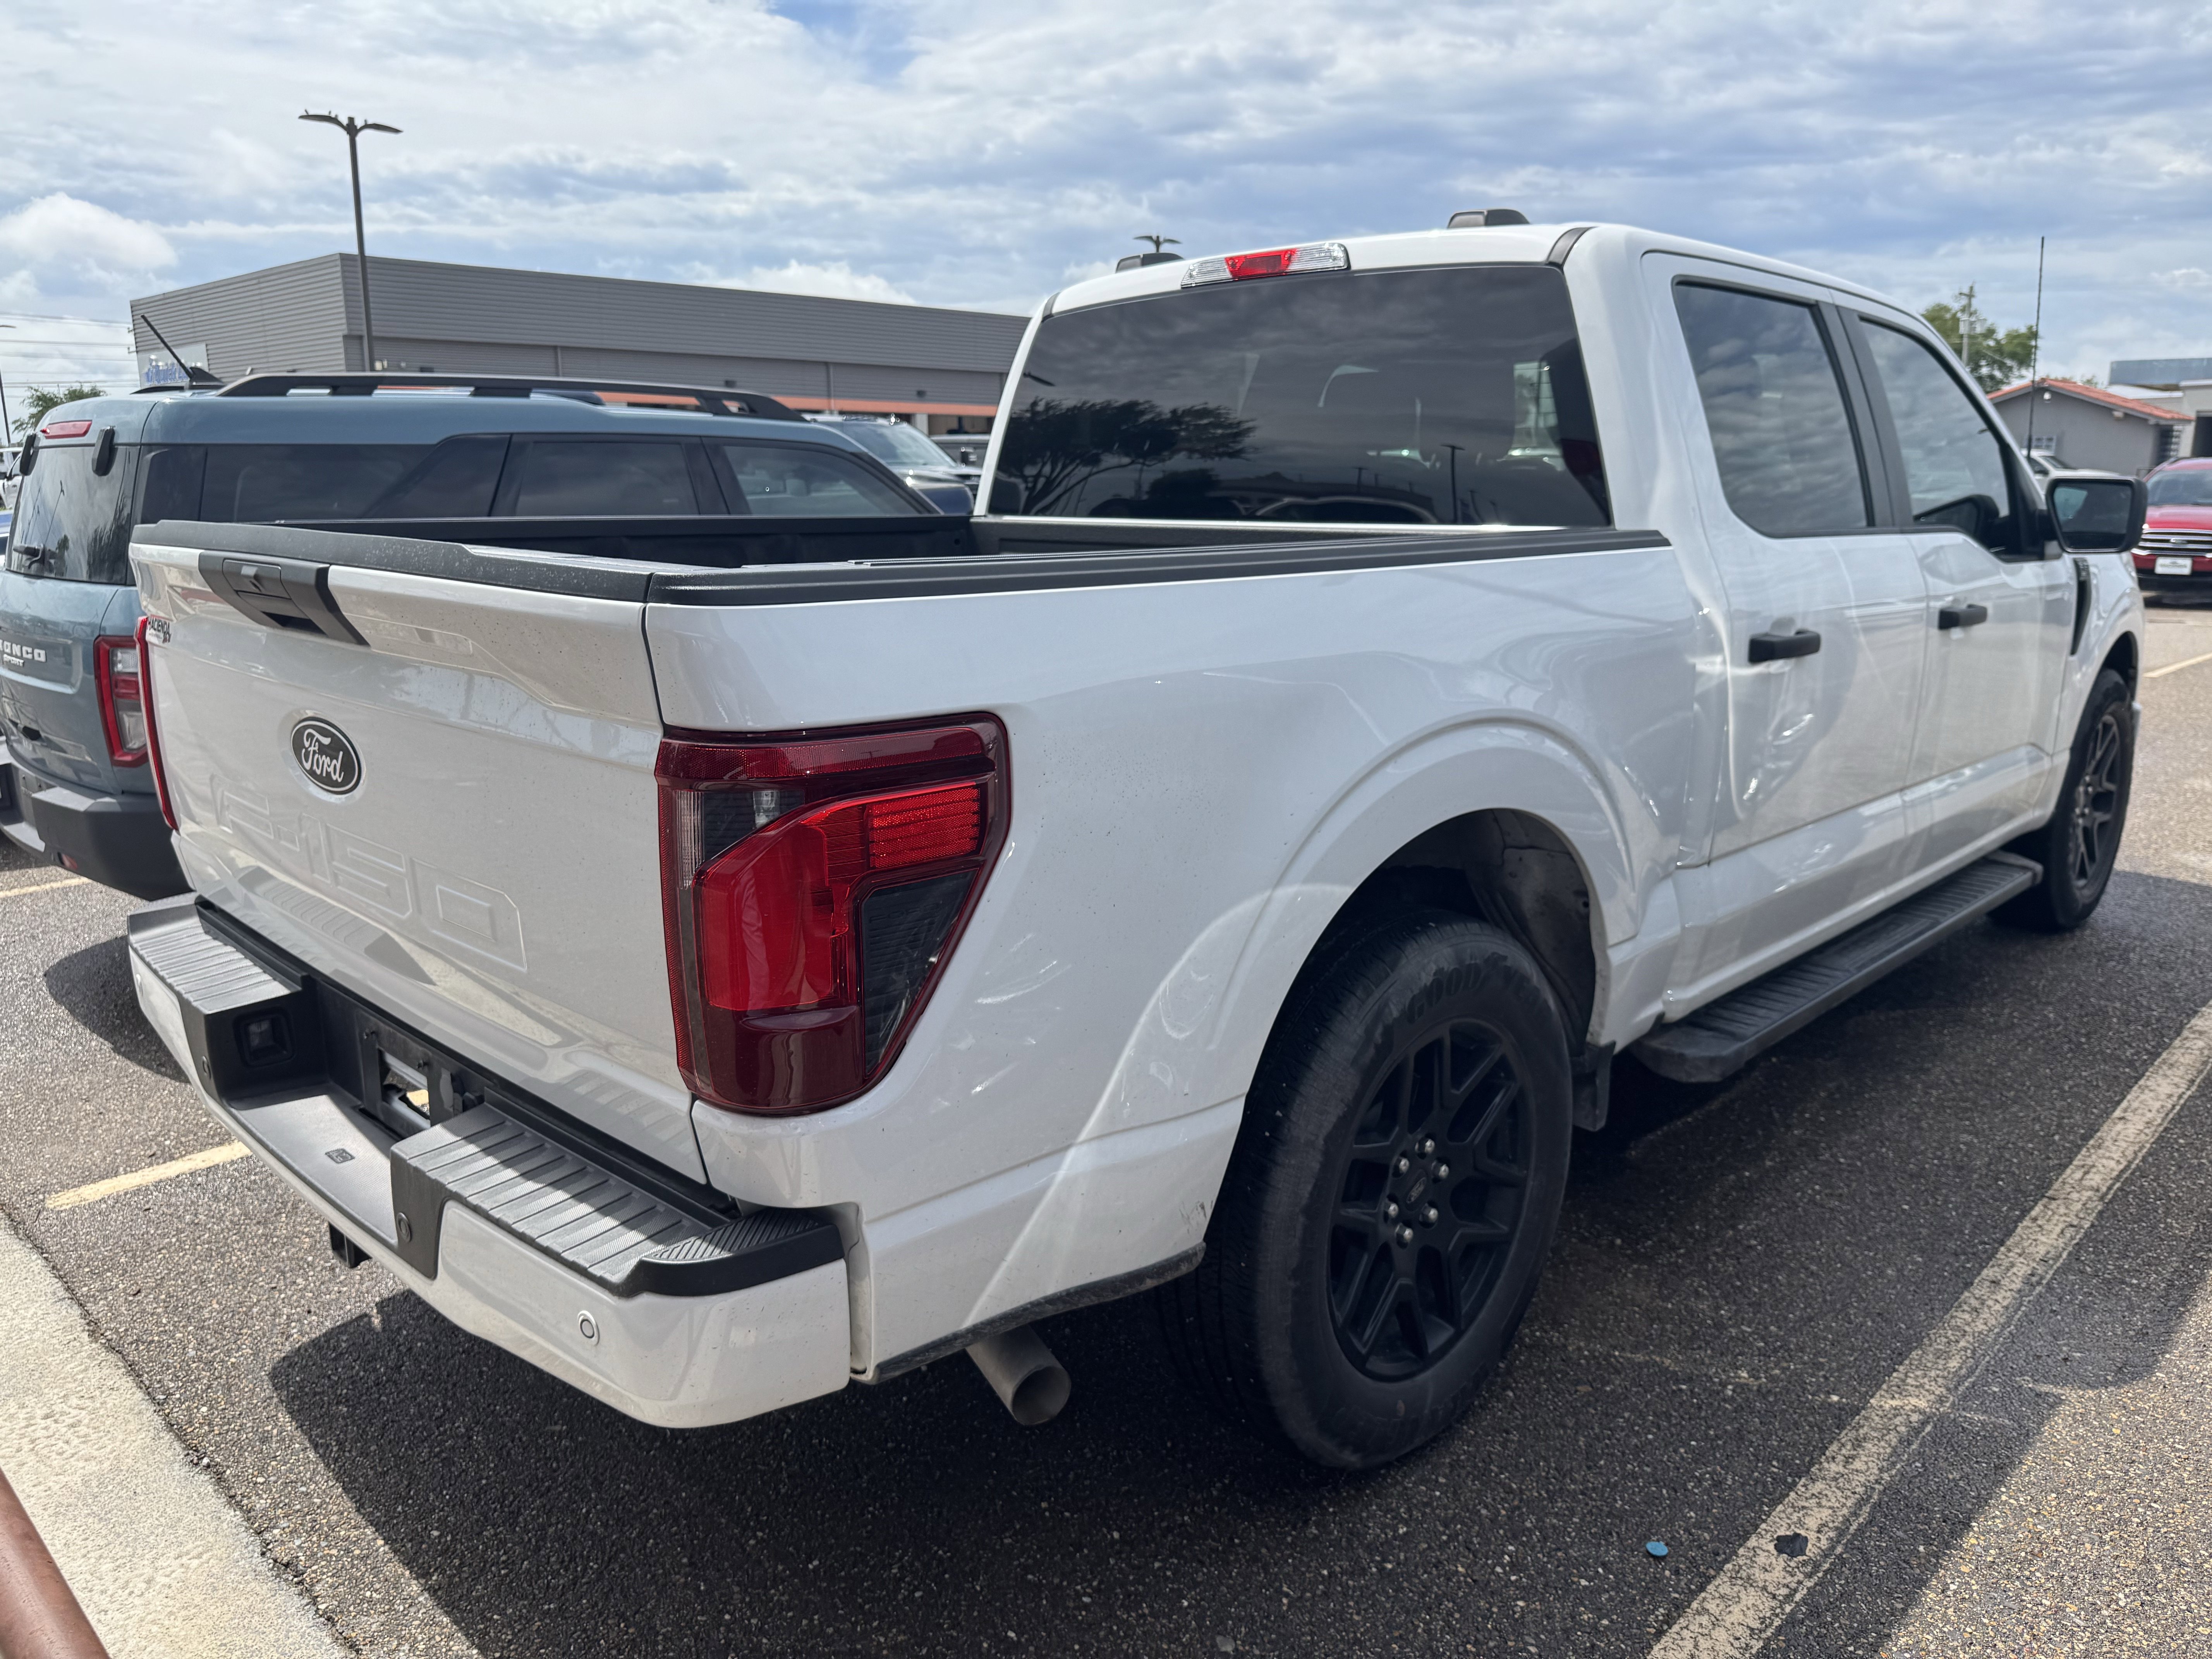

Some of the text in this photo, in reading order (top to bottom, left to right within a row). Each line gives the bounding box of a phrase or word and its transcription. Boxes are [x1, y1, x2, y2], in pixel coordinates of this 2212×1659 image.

[148, 616, 170, 634] HACIENDA
[302, 728, 344, 782] Ford
[210, 774, 527, 972] F-150
